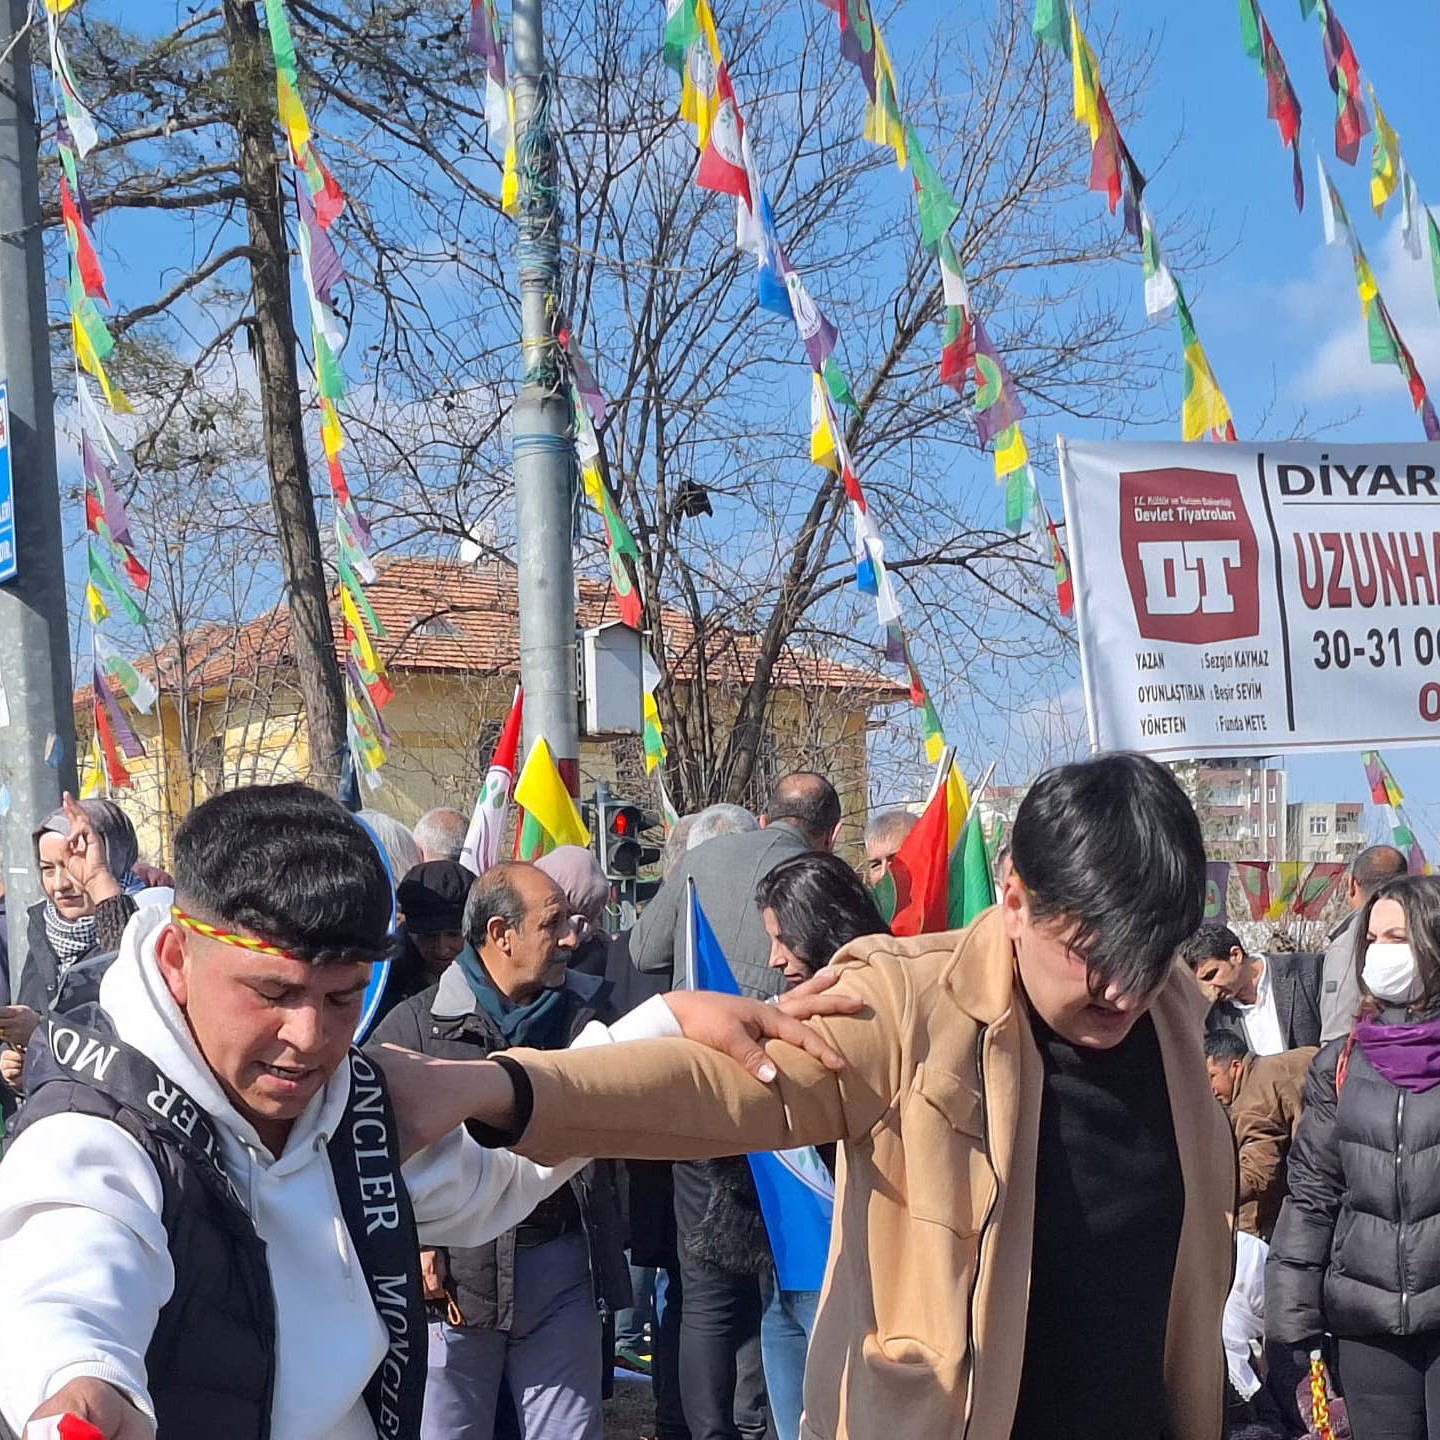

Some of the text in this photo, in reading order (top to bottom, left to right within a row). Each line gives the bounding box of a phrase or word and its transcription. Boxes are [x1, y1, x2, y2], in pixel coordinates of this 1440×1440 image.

[1134, 507, 1174, 522] Devlet
[1137, 539, 1242, 615] DT
[1135, 652, 1165, 670] YAZAN
[1204, 652, 1233, 672] Sezgin
[1234, 650, 1269, 667] KAYMAZ
[1312, 627, 1403, 671] 30-31
[1138, 684, 1205, 704] OYUNLAŞTIRAN
[1236, 678, 1262, 700] SEVİM
[1140, 714, 1186, 736] YÖNETEN
[1219, 716, 1244, 732] Funda
[1244, 715, 1267, 731] METE
[49, 1021, 119, 1082] MO
